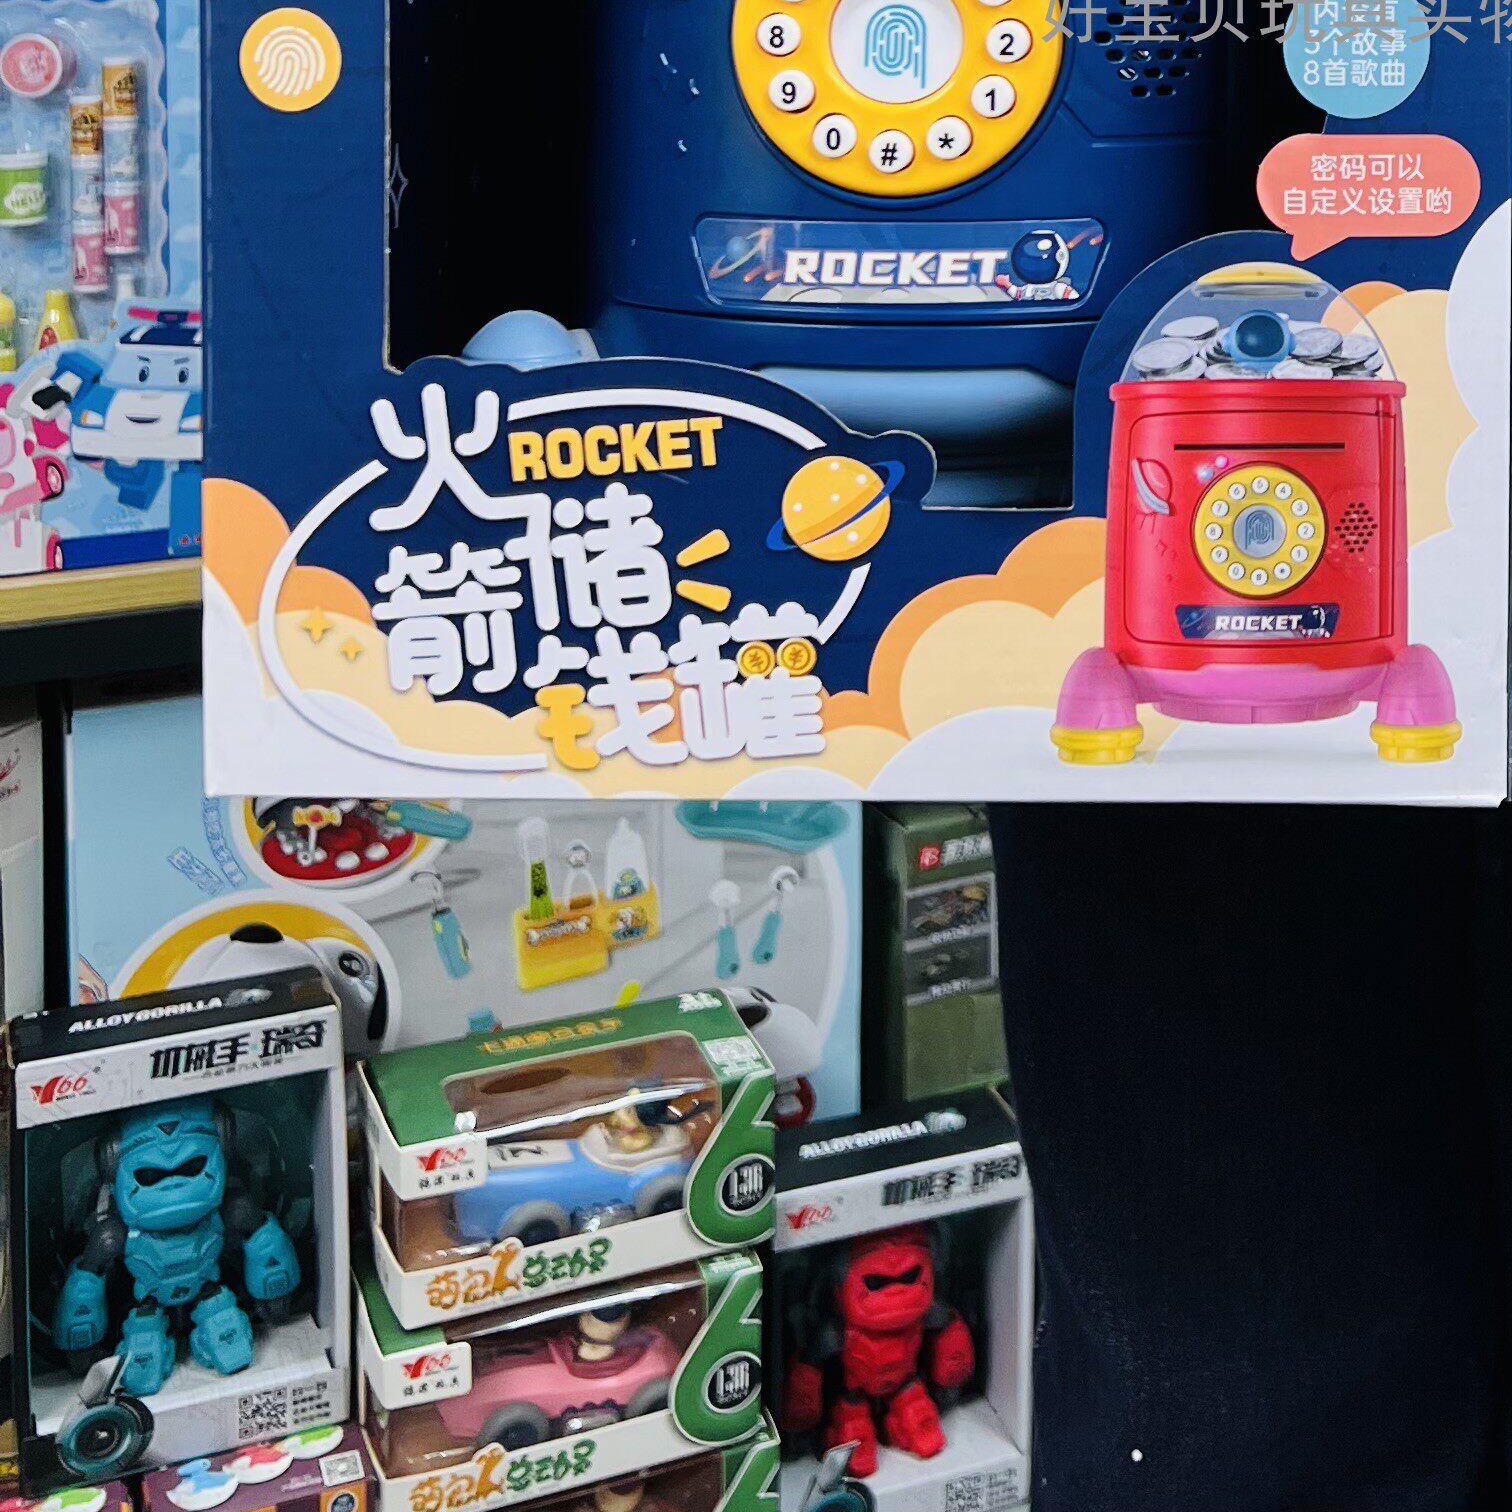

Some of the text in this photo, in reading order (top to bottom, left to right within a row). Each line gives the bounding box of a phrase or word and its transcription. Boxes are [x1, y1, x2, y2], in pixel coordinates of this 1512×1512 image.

[769, 25, 785, 49] 8
[999, 33, 1014, 56] 2
[1303, 59, 1406, 87] 8首歌曲
[781, 81, 797, 105] 9
[985, 89, 996, 111] 1
[826, 127, 841, 151] 0
[880, 143, 898, 167] #
[1311, 152, 1425, 182] 密码可以
[1283, 186, 1453, 216] 自定义设置哟
[784, 249, 1008, 285] ROCKET
[509, 417, 723, 483] ROCKET
[1215, 615, 1302, 631] ROCKET
